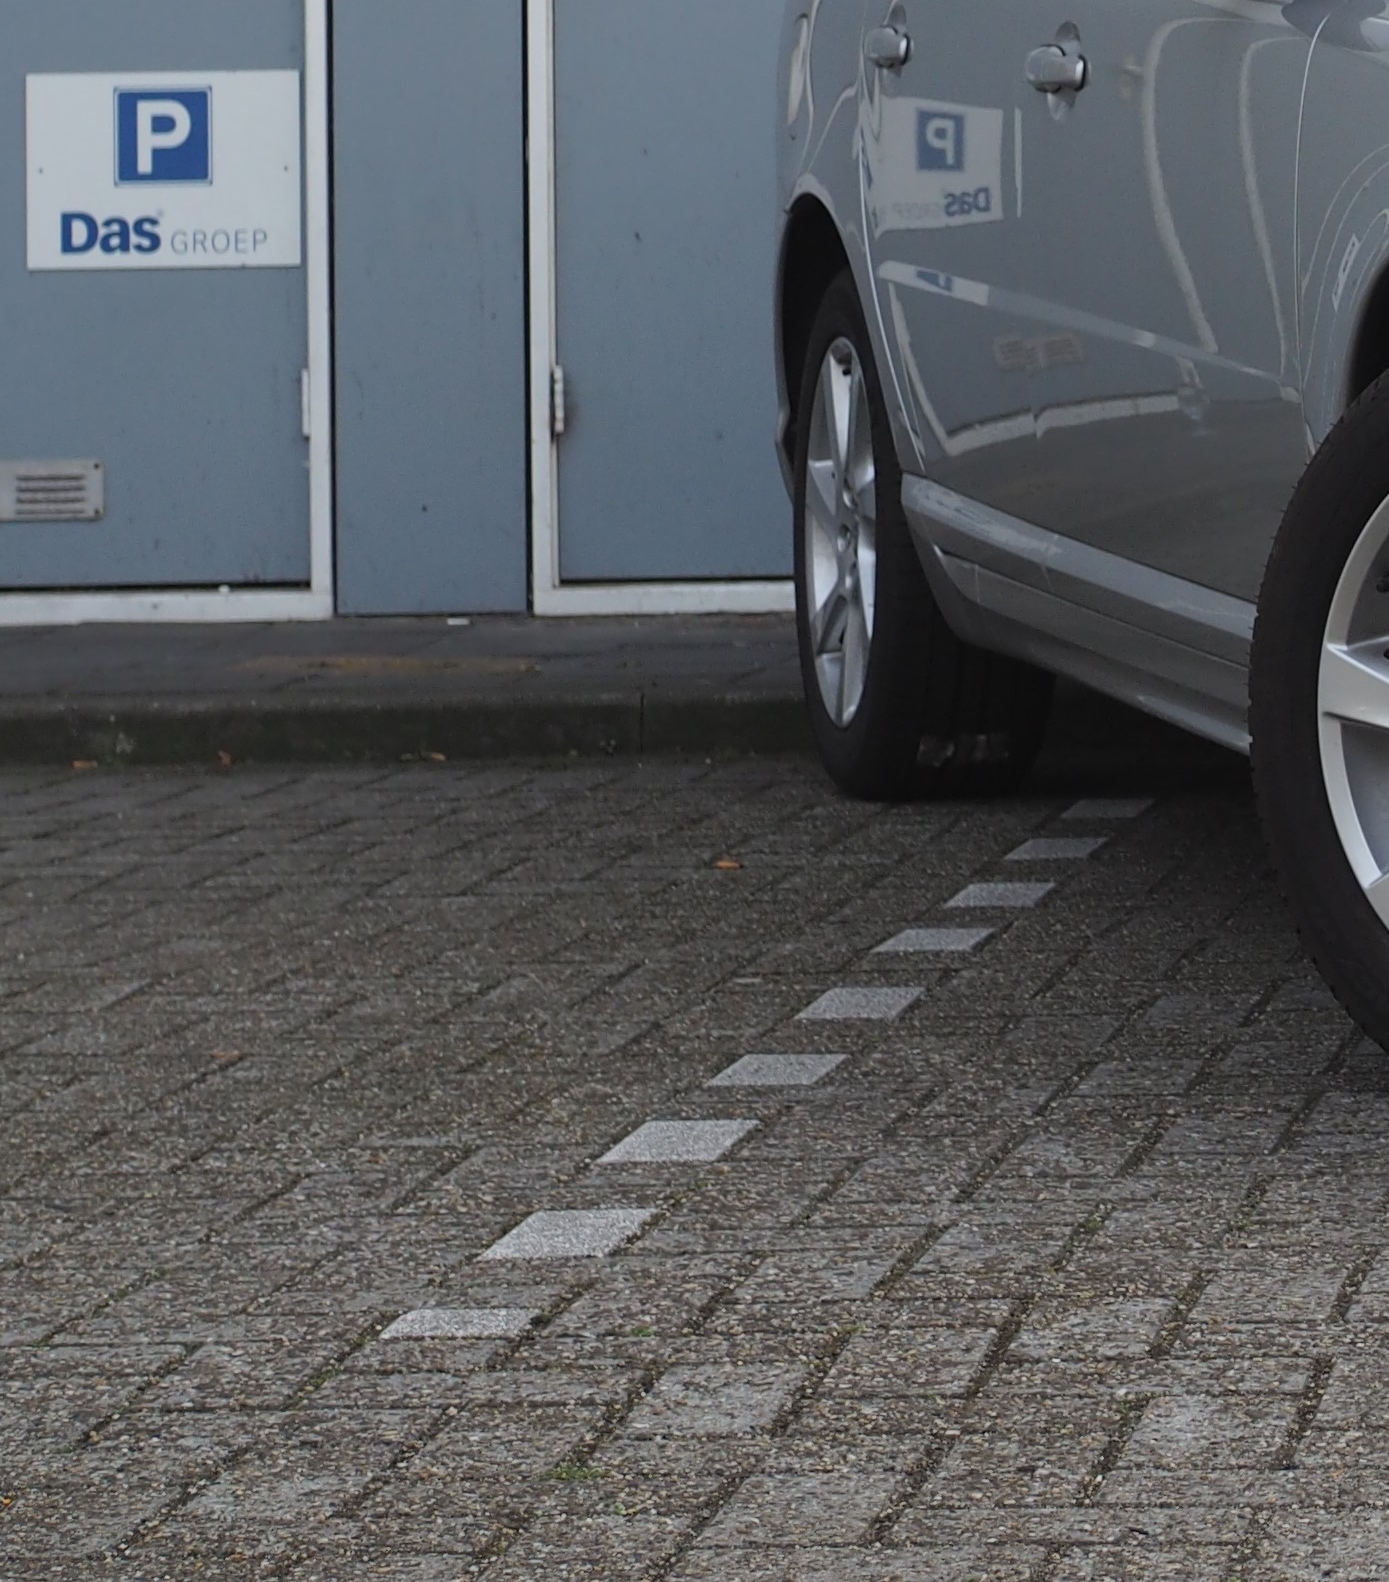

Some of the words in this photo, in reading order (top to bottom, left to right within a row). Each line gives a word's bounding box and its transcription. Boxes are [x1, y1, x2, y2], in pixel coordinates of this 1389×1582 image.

[136, 99, 191, 175] P
[60, 212, 161, 255] Das
[170, 228, 268, 255] GROEP
